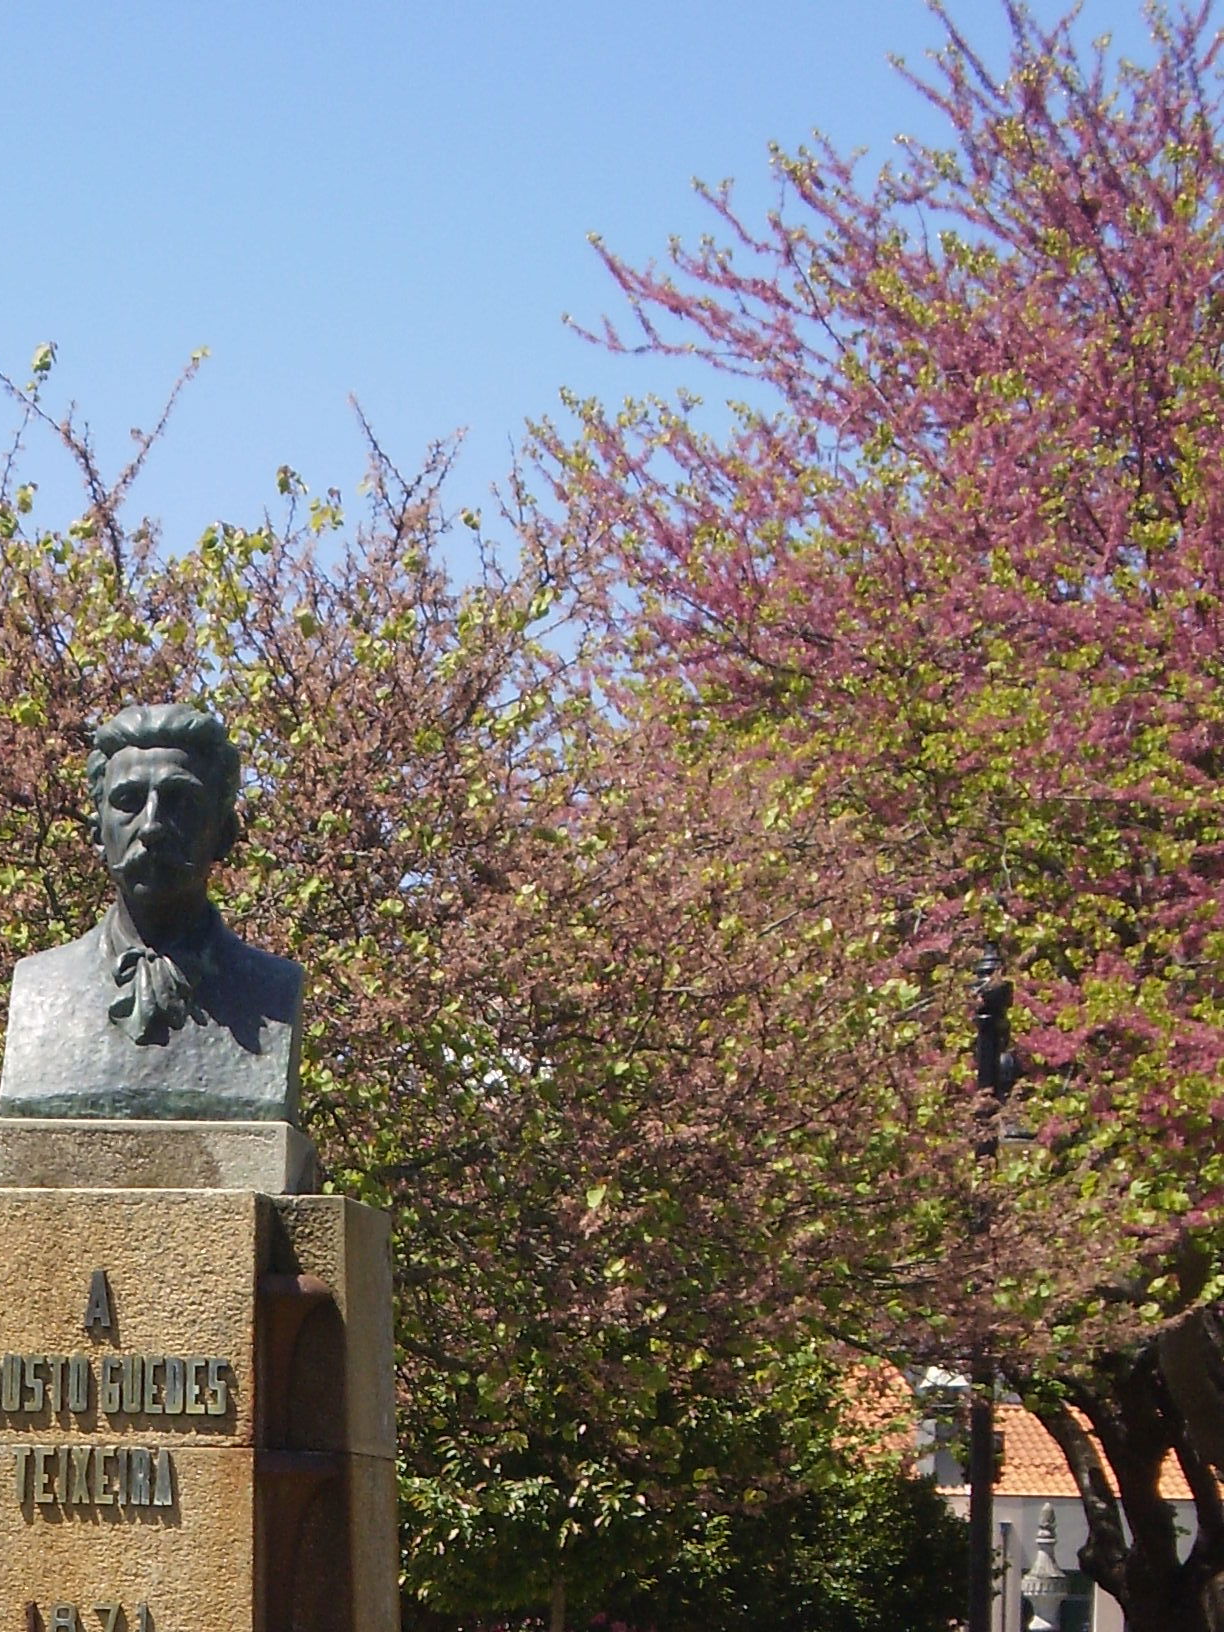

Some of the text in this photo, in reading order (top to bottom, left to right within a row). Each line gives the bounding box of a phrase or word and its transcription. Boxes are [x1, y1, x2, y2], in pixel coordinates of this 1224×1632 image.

[84, 1270, 112, 1328] A
[101, 1354, 228, 1415] GUEDES
[14, 1446, 173, 1506] TEIXEIRA
